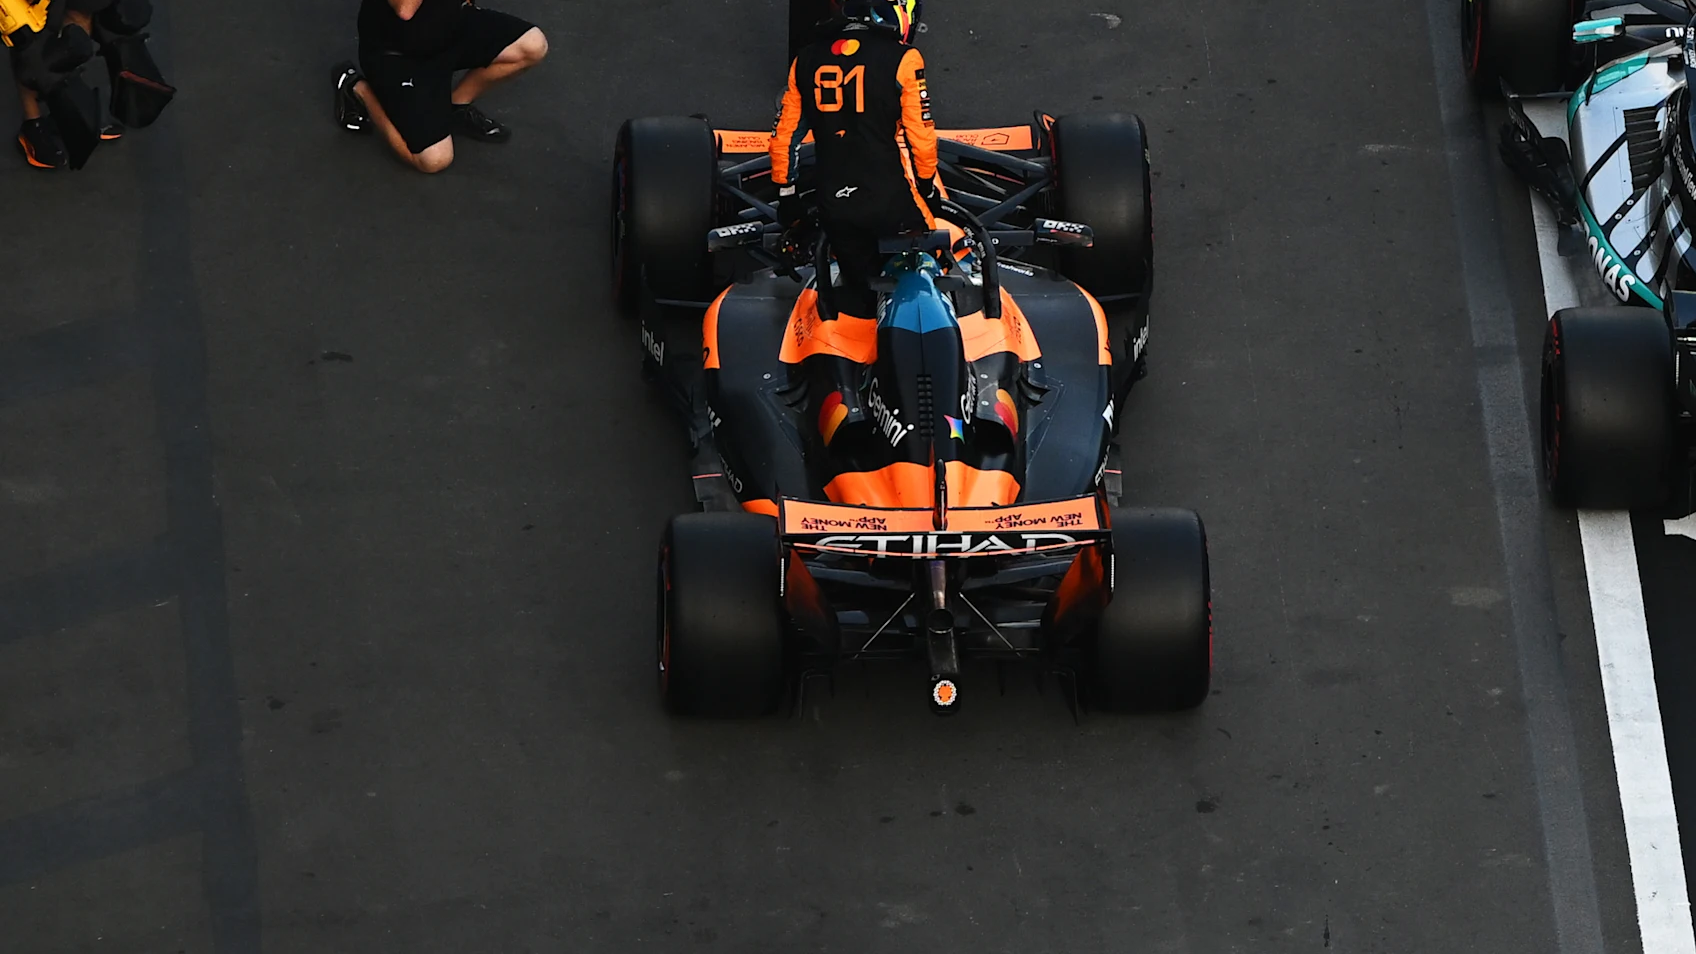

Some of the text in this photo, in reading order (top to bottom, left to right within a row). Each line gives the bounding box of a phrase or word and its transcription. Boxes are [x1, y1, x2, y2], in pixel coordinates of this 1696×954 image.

[814, 65, 865, 112] 81
[641, 319, 663, 366] intel
[1132, 315, 1148, 363] intel
[867, 377, 914, 447] Gemini
[801, 516, 886, 531] NEW MONEY
[994, 511, 1080, 529] NEW MONEY
[815, 532, 1077, 559] ETIHAD
